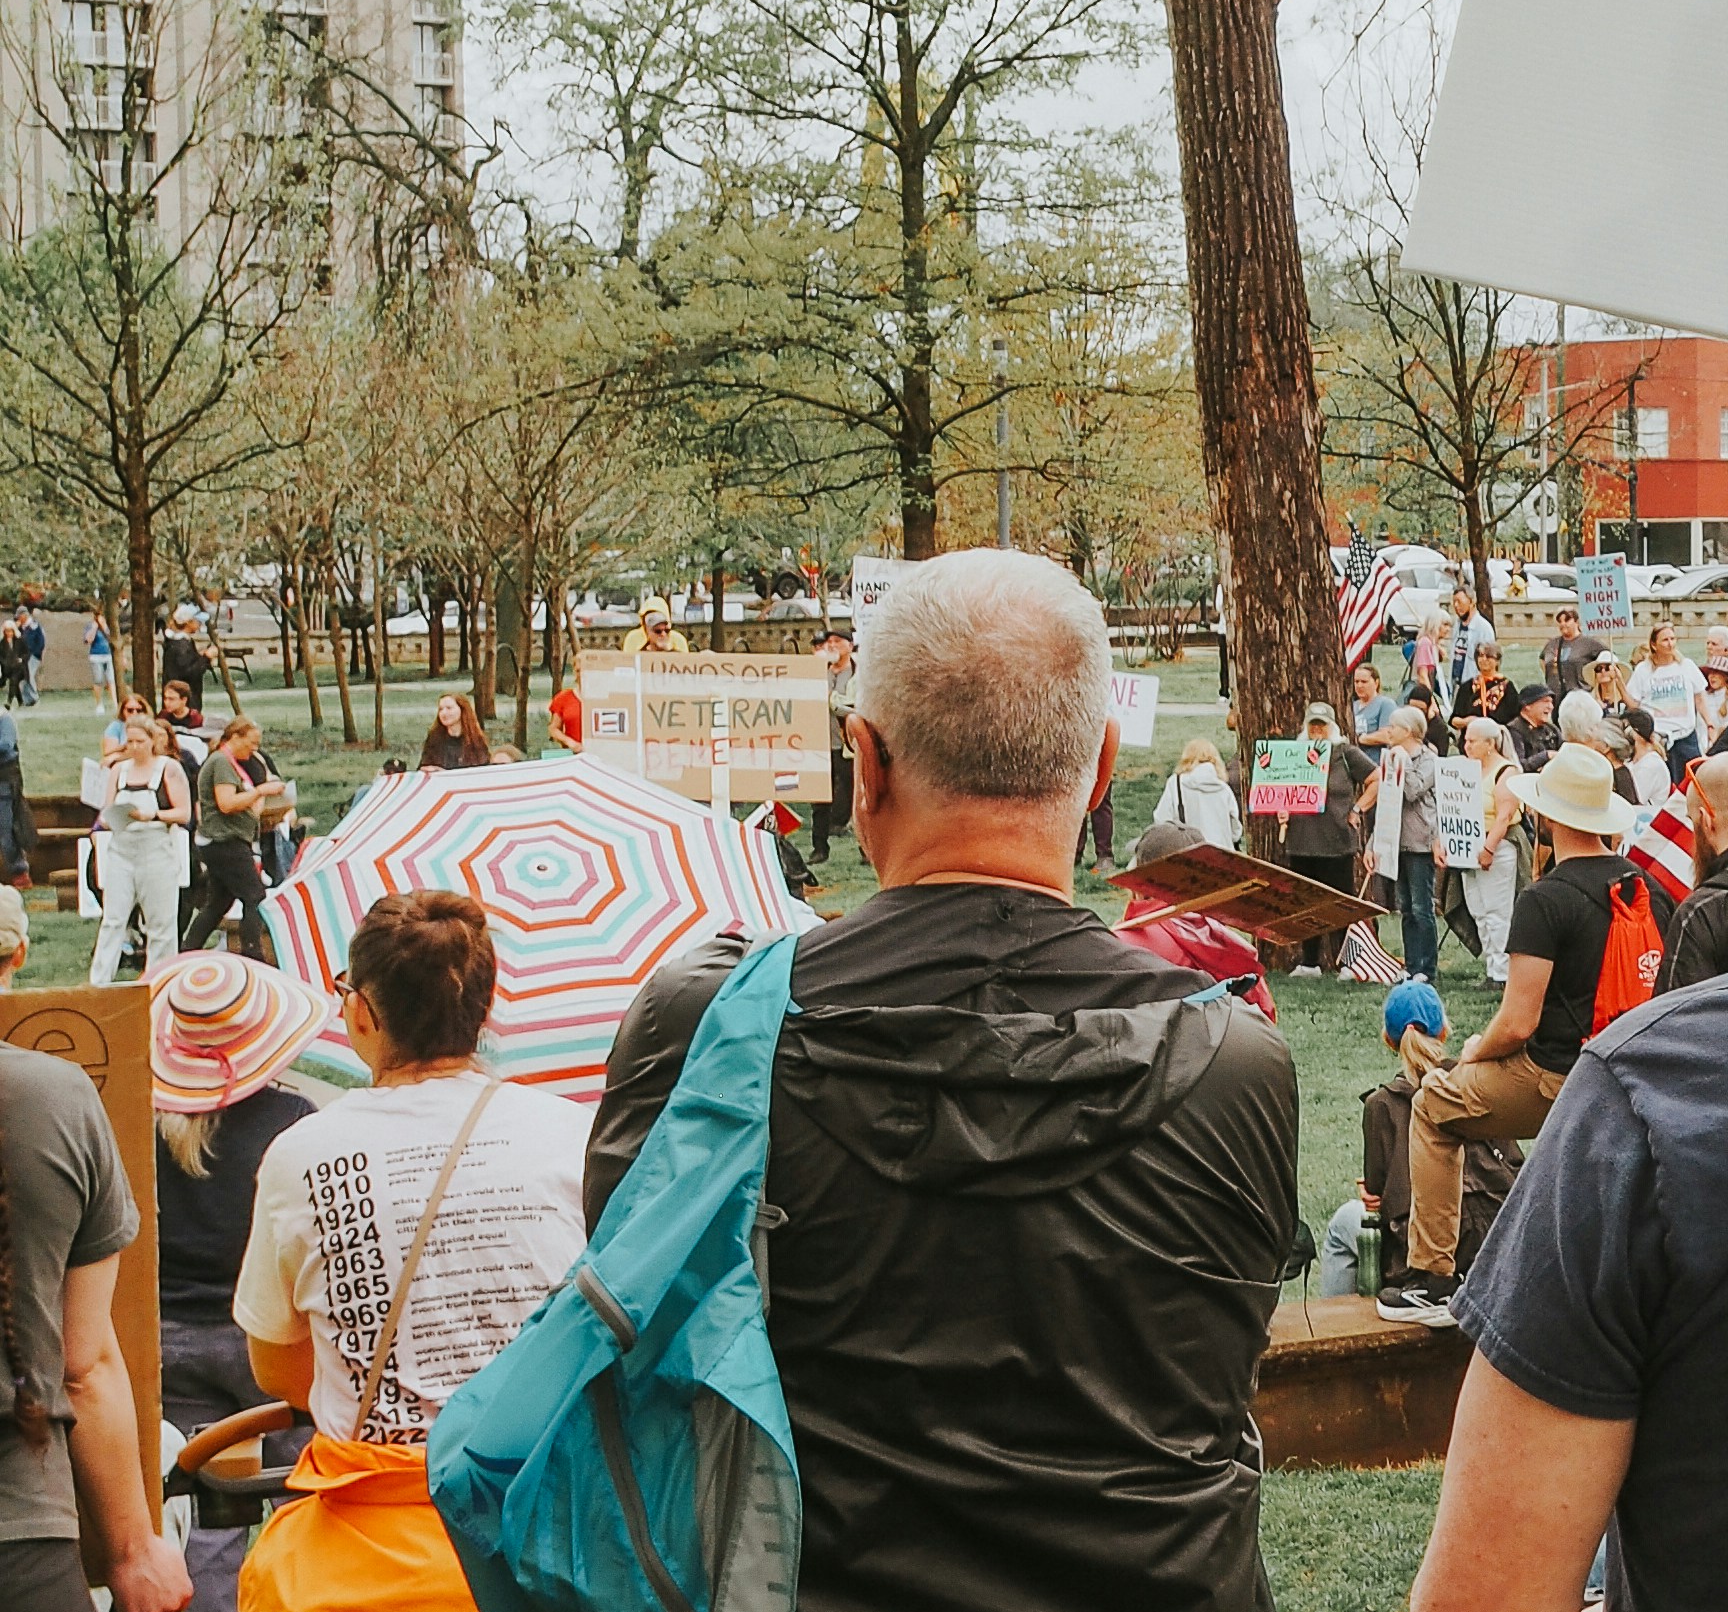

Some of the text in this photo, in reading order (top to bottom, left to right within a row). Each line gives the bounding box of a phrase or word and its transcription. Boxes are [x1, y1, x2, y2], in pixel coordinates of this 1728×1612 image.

[855, 581, 891, 593] HAND
[1585, 590, 1619, 604] RIGHT
[1597, 605, 1613, 617] VS
[1586, 616, 1627, 631] WRONG
[647, 698, 793, 729] VETERAN
[1440, 767, 1460, 779] Keep
[1256, 785, 1319, 807] NO NAZIS
[1442, 791, 1472, 803] NASTY
[1440, 816, 1481, 838] HANDS
[1448, 838, 1472, 858] OFF
[303, 1152, 368, 1189] 1900
[309, 1174, 371, 1211] 1910
[313, 1197, 375, 1236] 1920
[317, 1220, 381, 1259] 1924
[478, 1230, 507, 1241] equal
[322, 1247, 385, 1283] 1963
[475, 1263, 505, 1273] could
[325, 1273, 390, 1307] 1965
[328, 1300, 392, 1329] 1969
